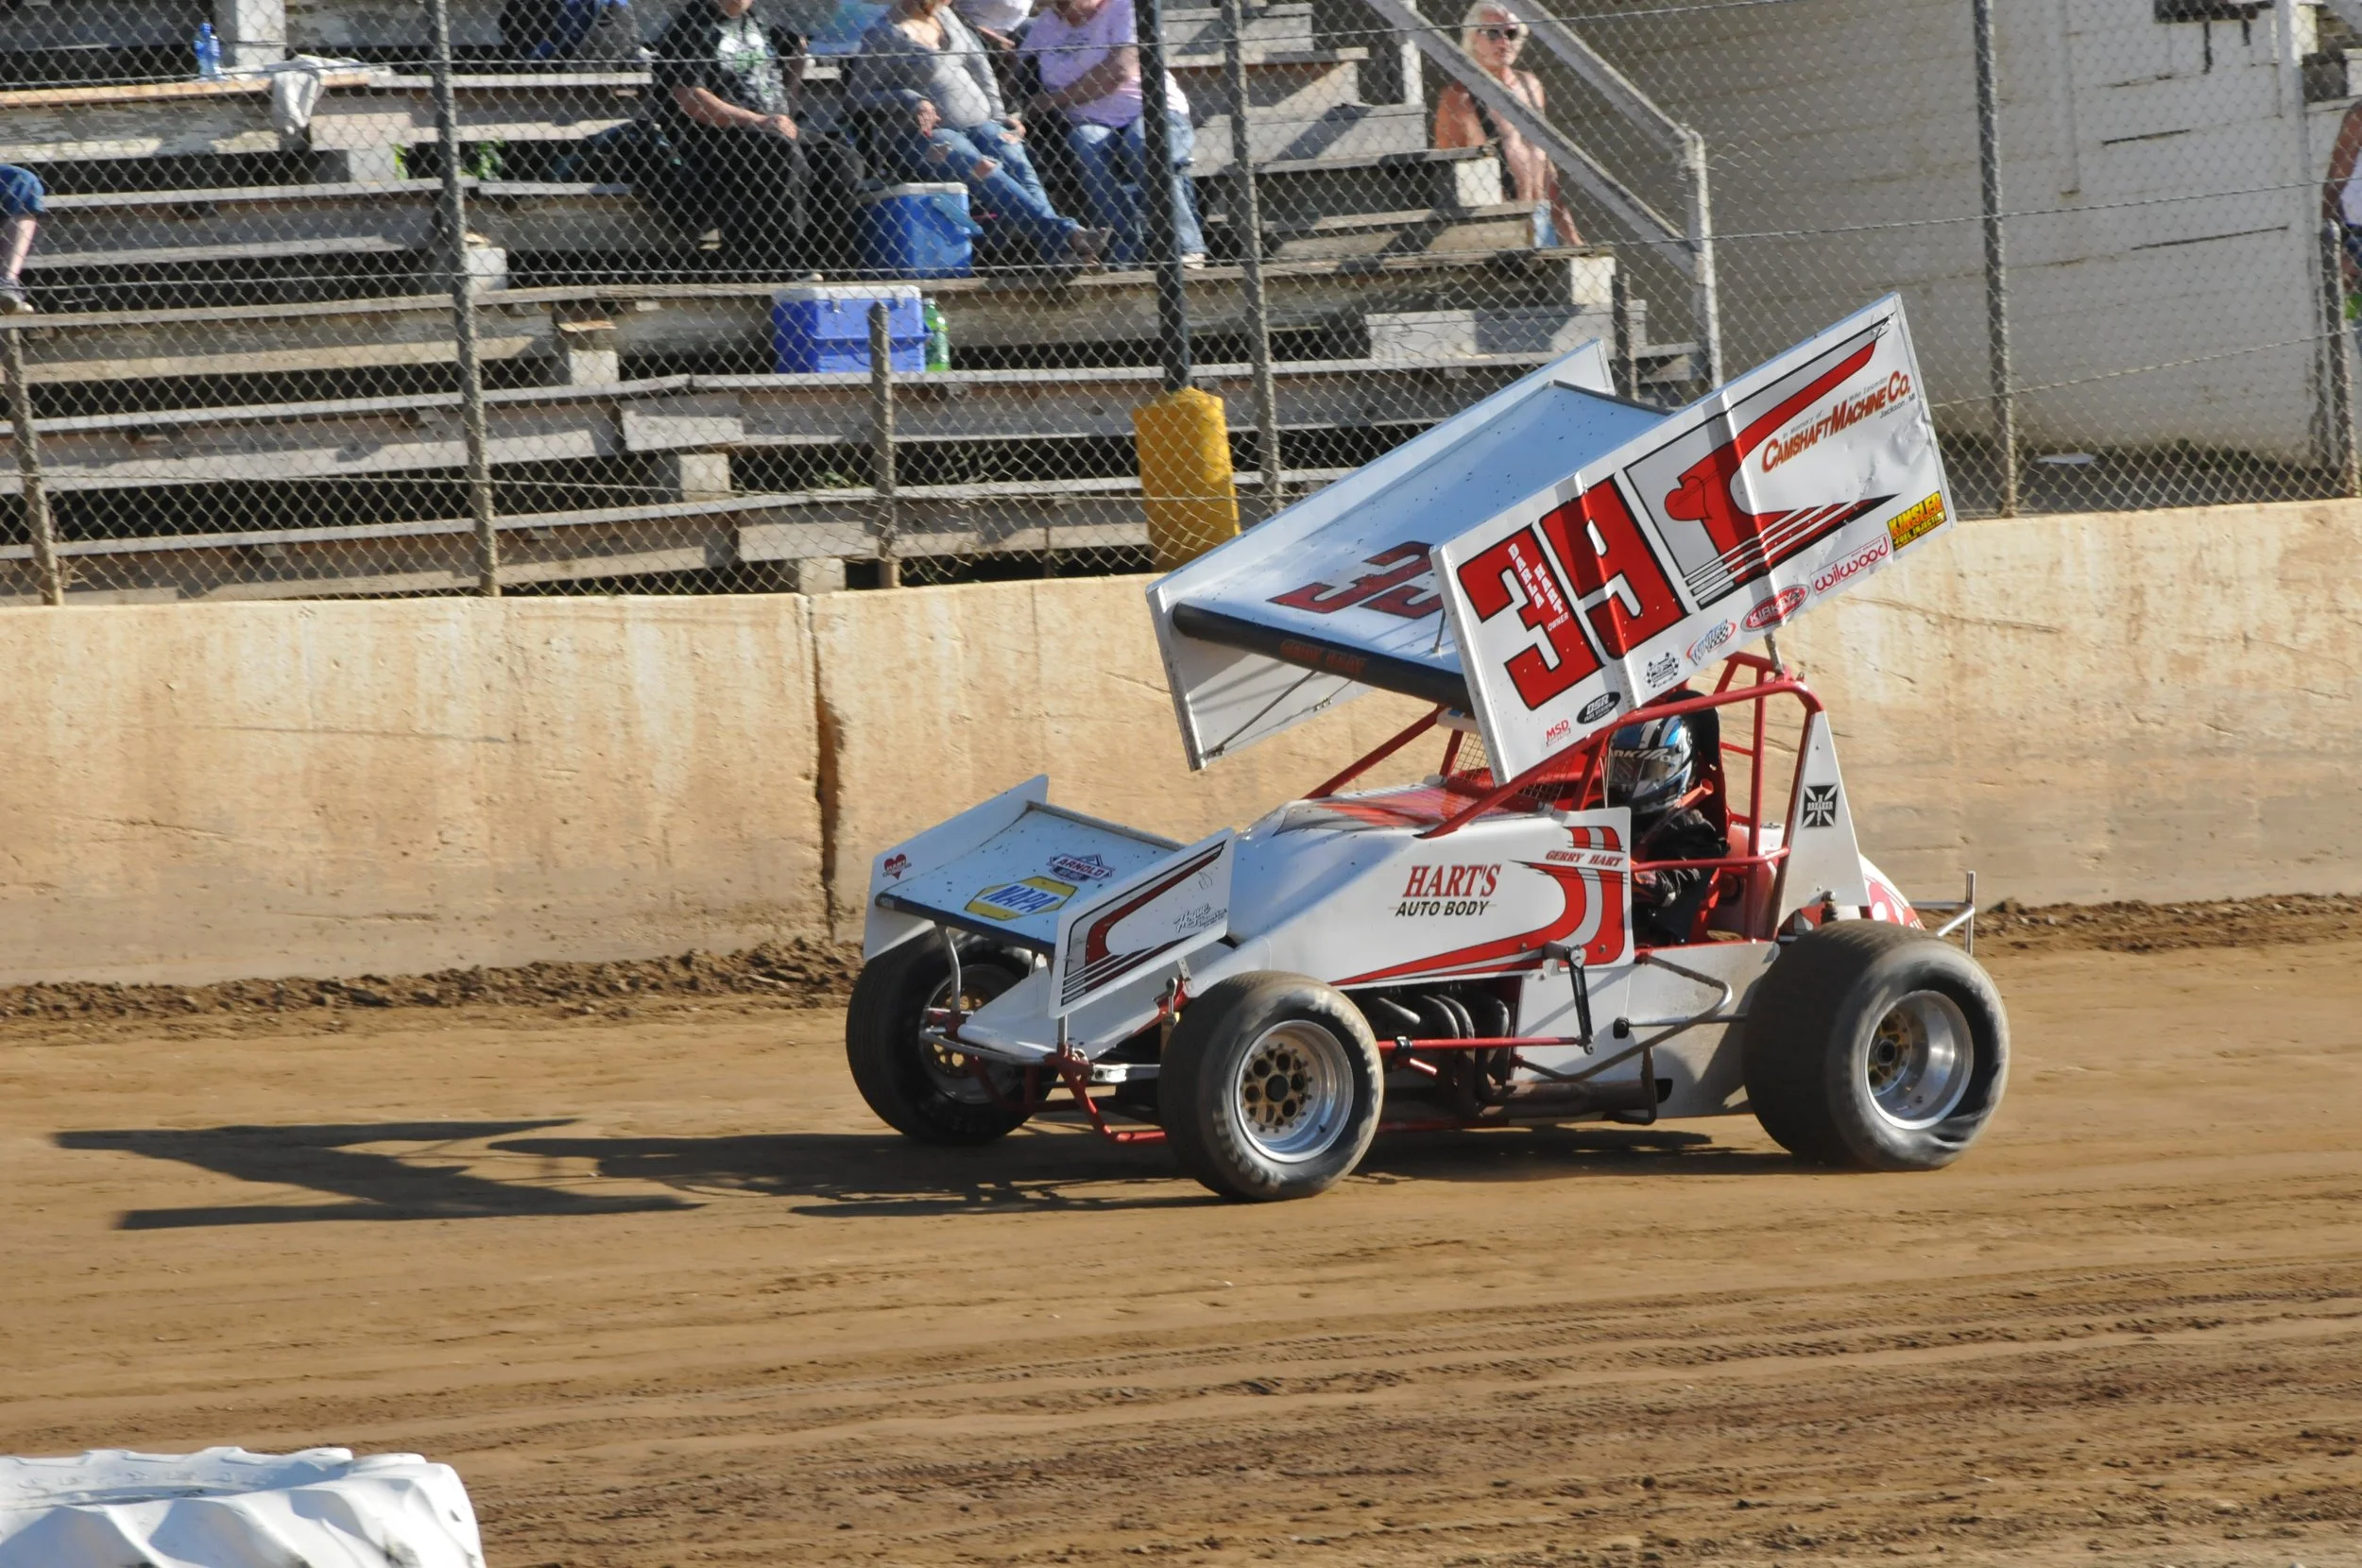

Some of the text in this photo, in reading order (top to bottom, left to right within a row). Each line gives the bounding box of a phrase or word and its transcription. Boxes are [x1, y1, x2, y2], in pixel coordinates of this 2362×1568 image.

[1761, 369, 1911, 474] CAMSHAFT MACHINE CO.
[1889, 491, 1944, 539] KINSLER
[1814, 536, 1889, 591] wilwood
[1546, 719, 1569, 742] MSD
[1057, 857, 1105, 877] ARNOLD
[1545, 850, 1624, 867] GERRY HART
[1402, 863, 1502, 897] HART'S
[982, 884, 1060, 913] NAPA
[1395, 900, 1490, 917] AUTO BODY
